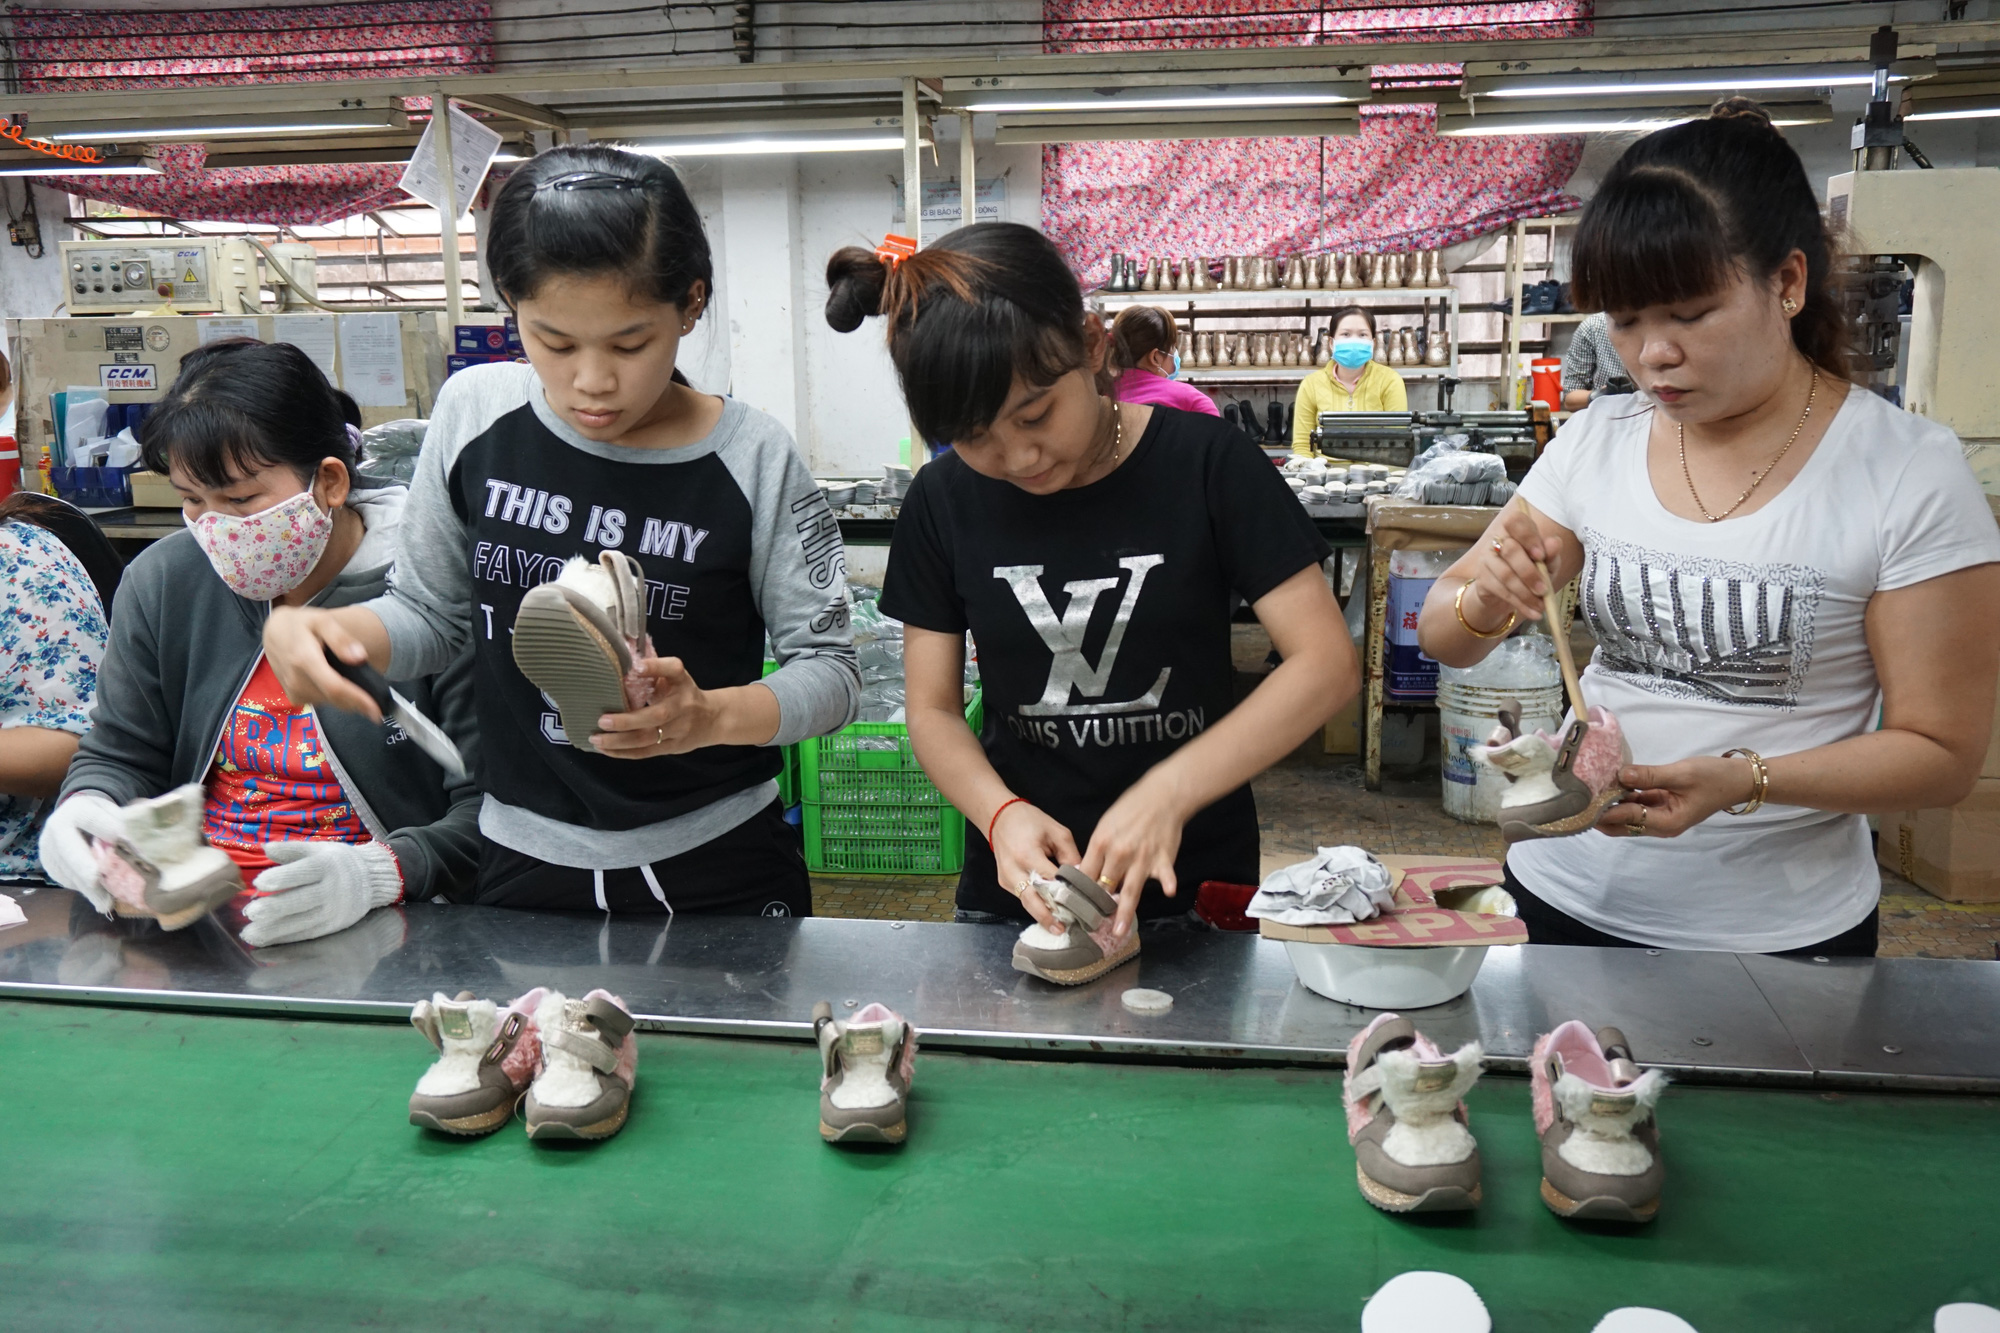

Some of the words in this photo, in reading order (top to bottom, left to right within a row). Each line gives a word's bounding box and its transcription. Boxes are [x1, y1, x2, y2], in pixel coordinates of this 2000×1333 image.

[107, 368, 148, 378] CCM
[485, 479, 573, 534] THIS
[584, 505, 627, 548] IS
[639, 517, 709, 563] MY
